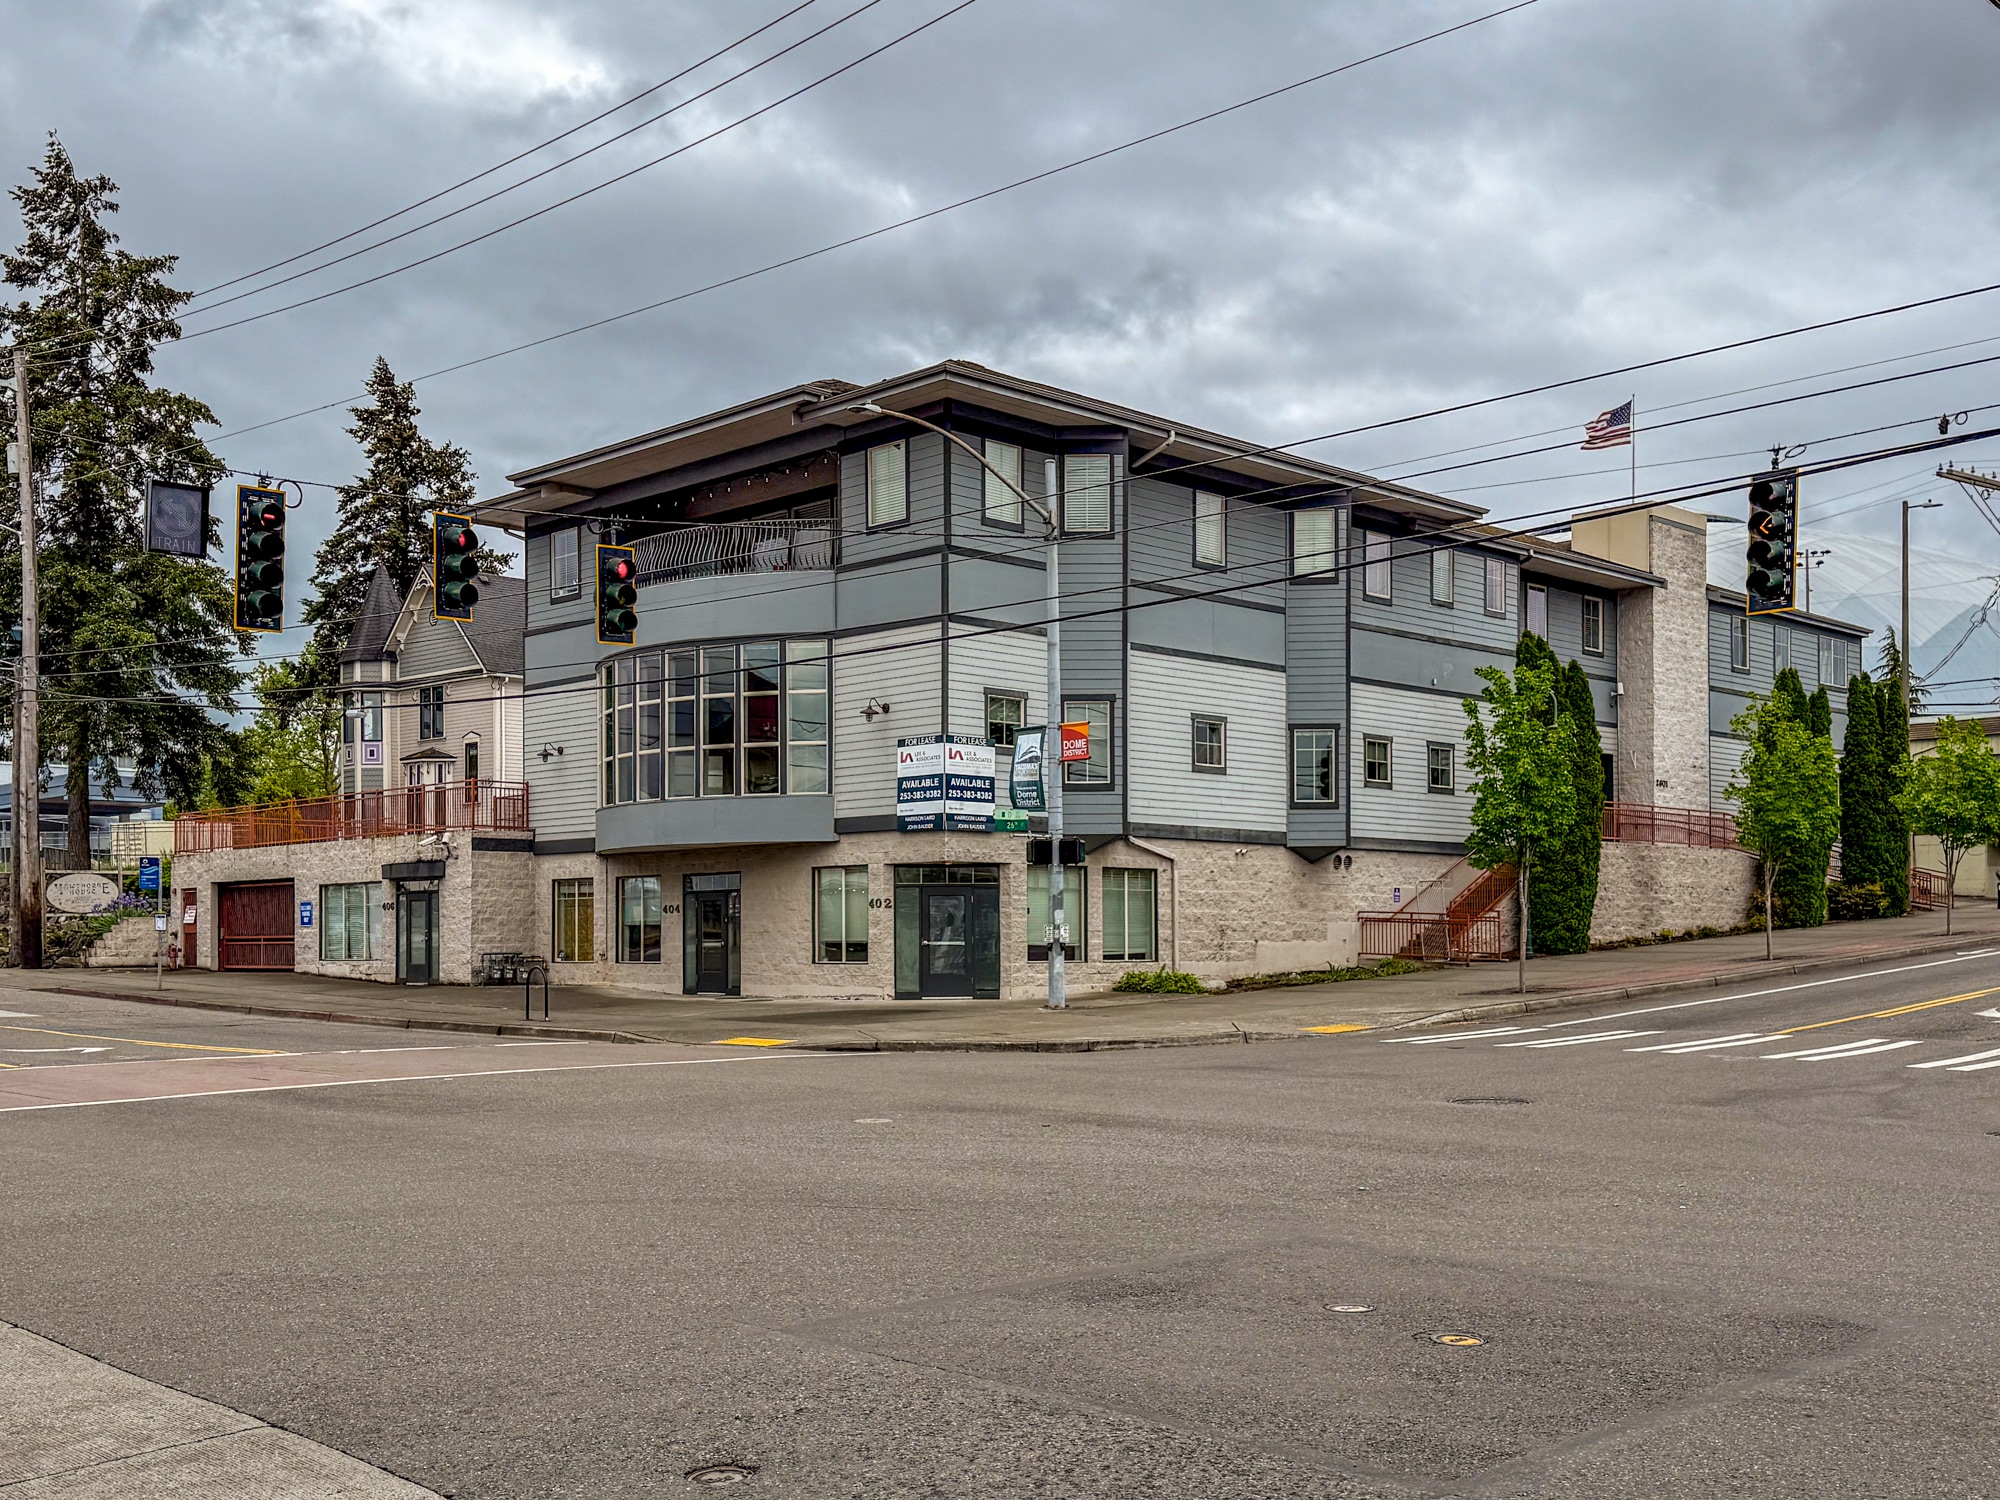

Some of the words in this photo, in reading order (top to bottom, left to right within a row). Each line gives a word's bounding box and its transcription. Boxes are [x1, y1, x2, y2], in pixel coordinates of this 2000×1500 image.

[156, 536, 196, 553] TRAIN
[918, 736, 936, 745] LEASE
[953, 736, 967, 744] FOR
[967, 737, 987, 746] LEASE
[1063, 739, 1087, 749] DOME
[915, 754, 941, 762] ASSOCIATES
[902, 778, 939, 789] AVAILABLE
[950, 778, 991, 788] AVAILABLE
[900, 790, 941, 800] 253-383-8382
[948, 789, 993, 800] 253-383-8382
[1016, 790, 1038, 798] Dome
[1016, 798, 1041, 806] District
[868, 897, 893, 909] 402
[662, 904, 681, 914] 404
